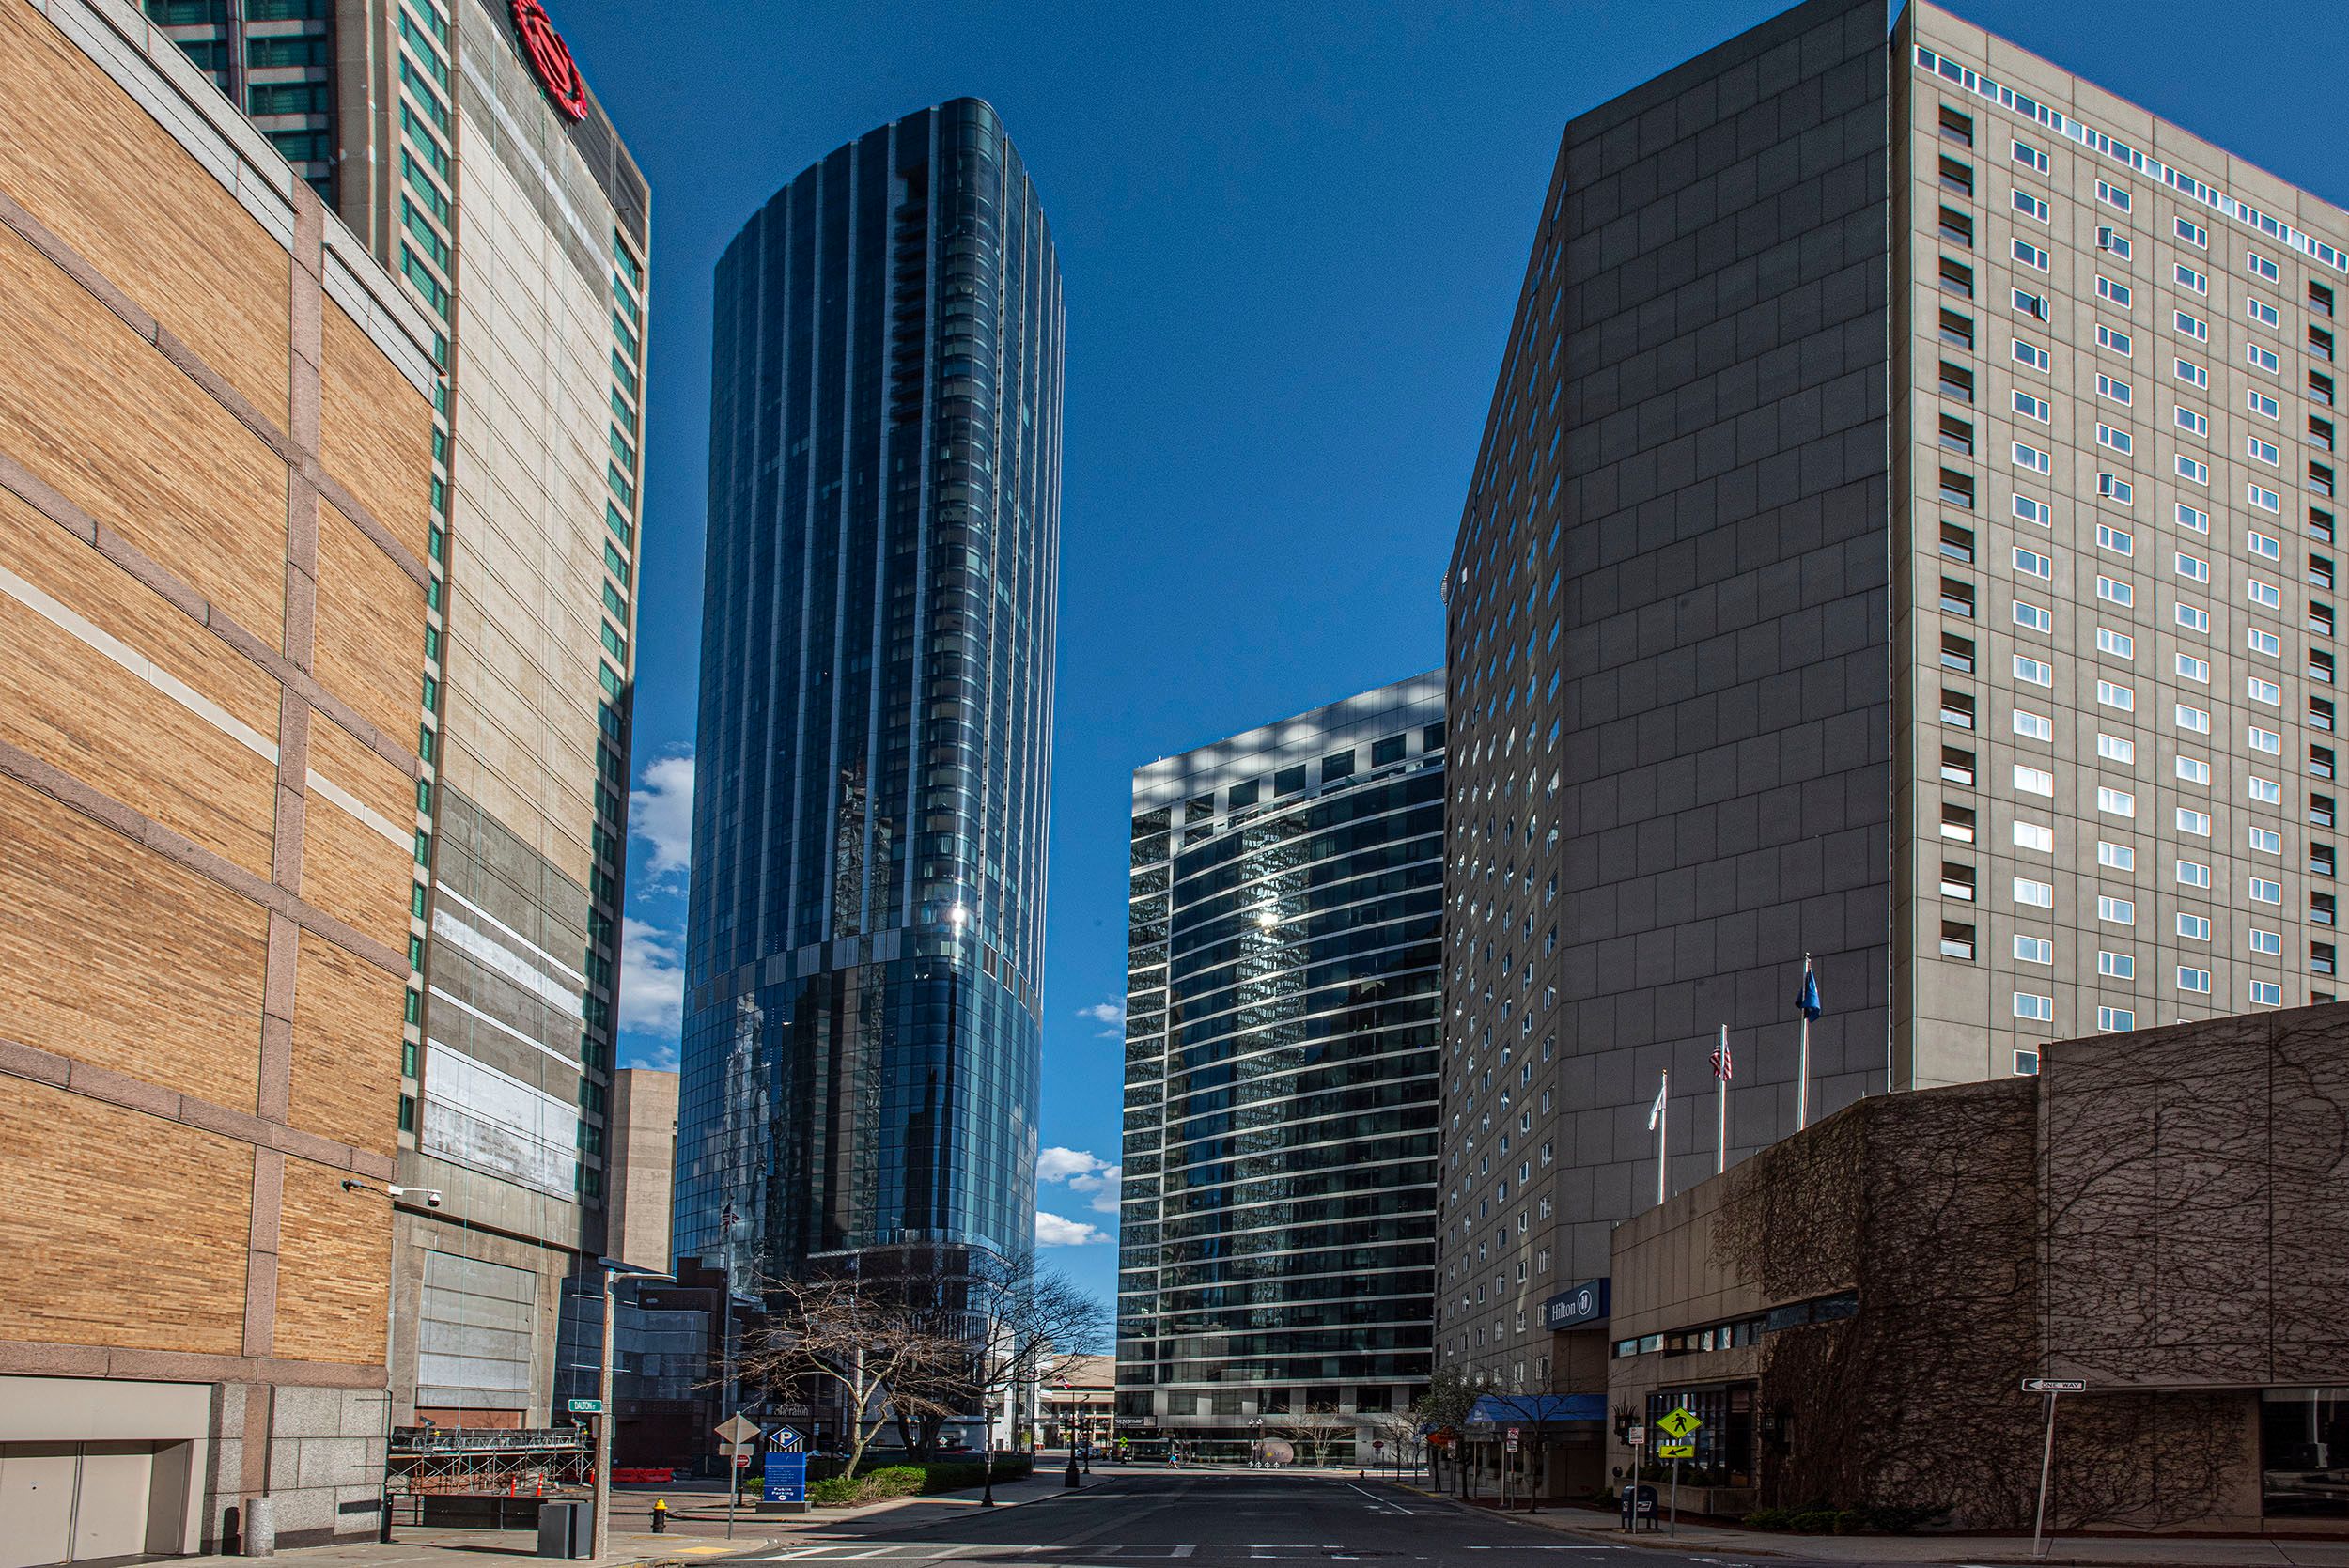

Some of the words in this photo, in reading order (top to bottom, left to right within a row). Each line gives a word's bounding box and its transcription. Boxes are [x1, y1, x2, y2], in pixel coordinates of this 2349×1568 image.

[1551, 1301, 1576, 1321] Hilton
[574, 1401, 593, 1410] DALTON
[780, 1432, 793, 1444] P
